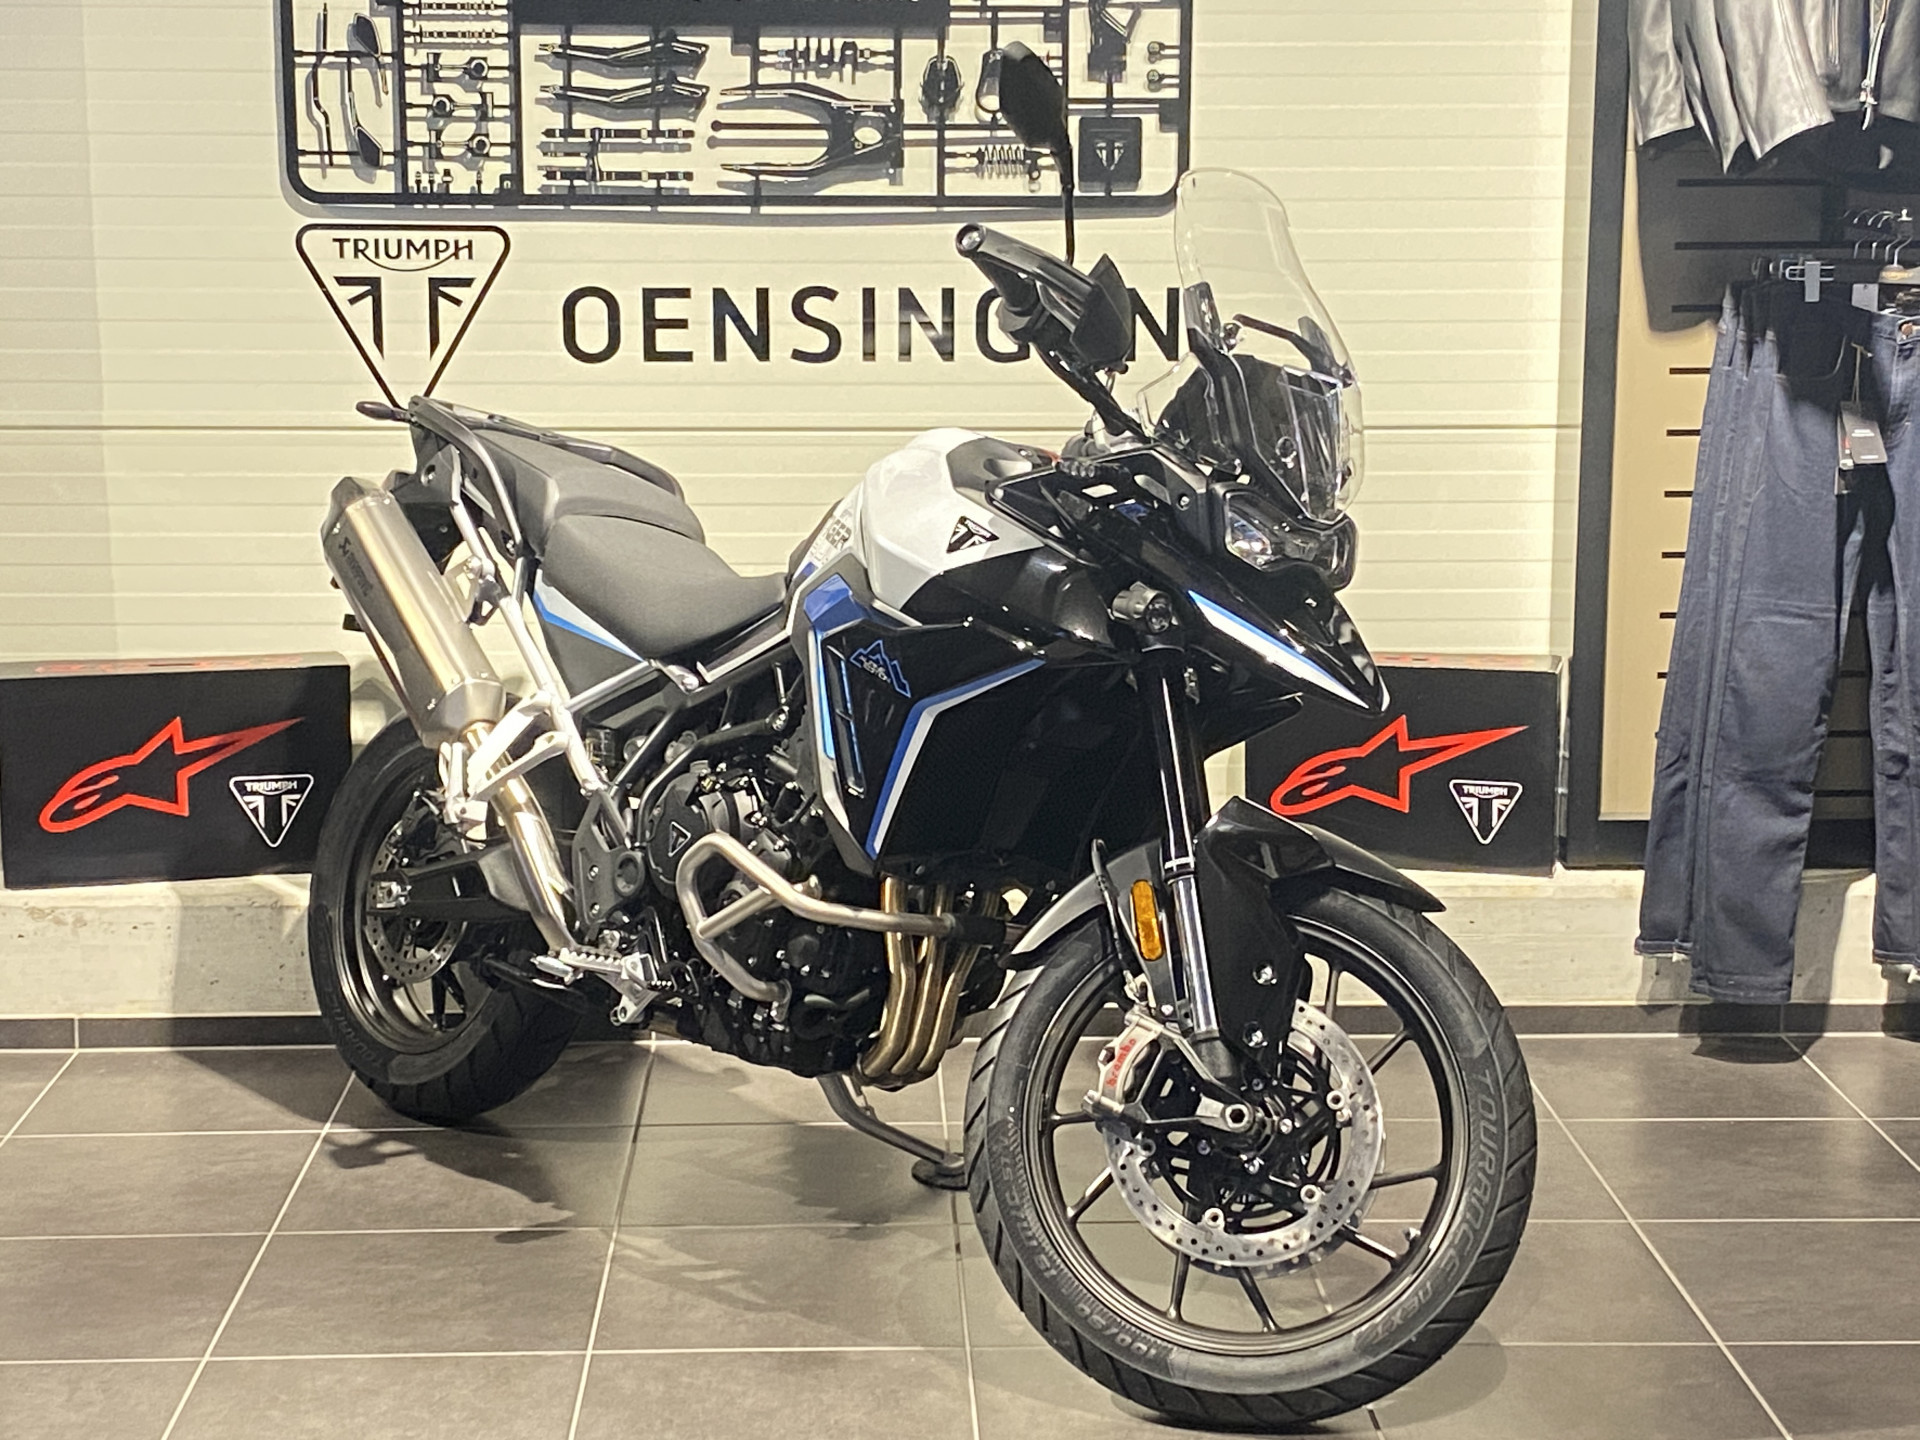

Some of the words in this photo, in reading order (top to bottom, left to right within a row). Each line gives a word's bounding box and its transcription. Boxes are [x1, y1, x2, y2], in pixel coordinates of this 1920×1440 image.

[332, 237, 473, 266] TRIUMPH
[562, 286, 1179, 363] OENSINGN
[244, 780, 298, 793] TRIUMPH
[1462, 785, 1508, 797] TRIUMPH
[1105, 1038, 1136, 1087] brembo
[1438, 1069, 1500, 1283] TOURANCE
